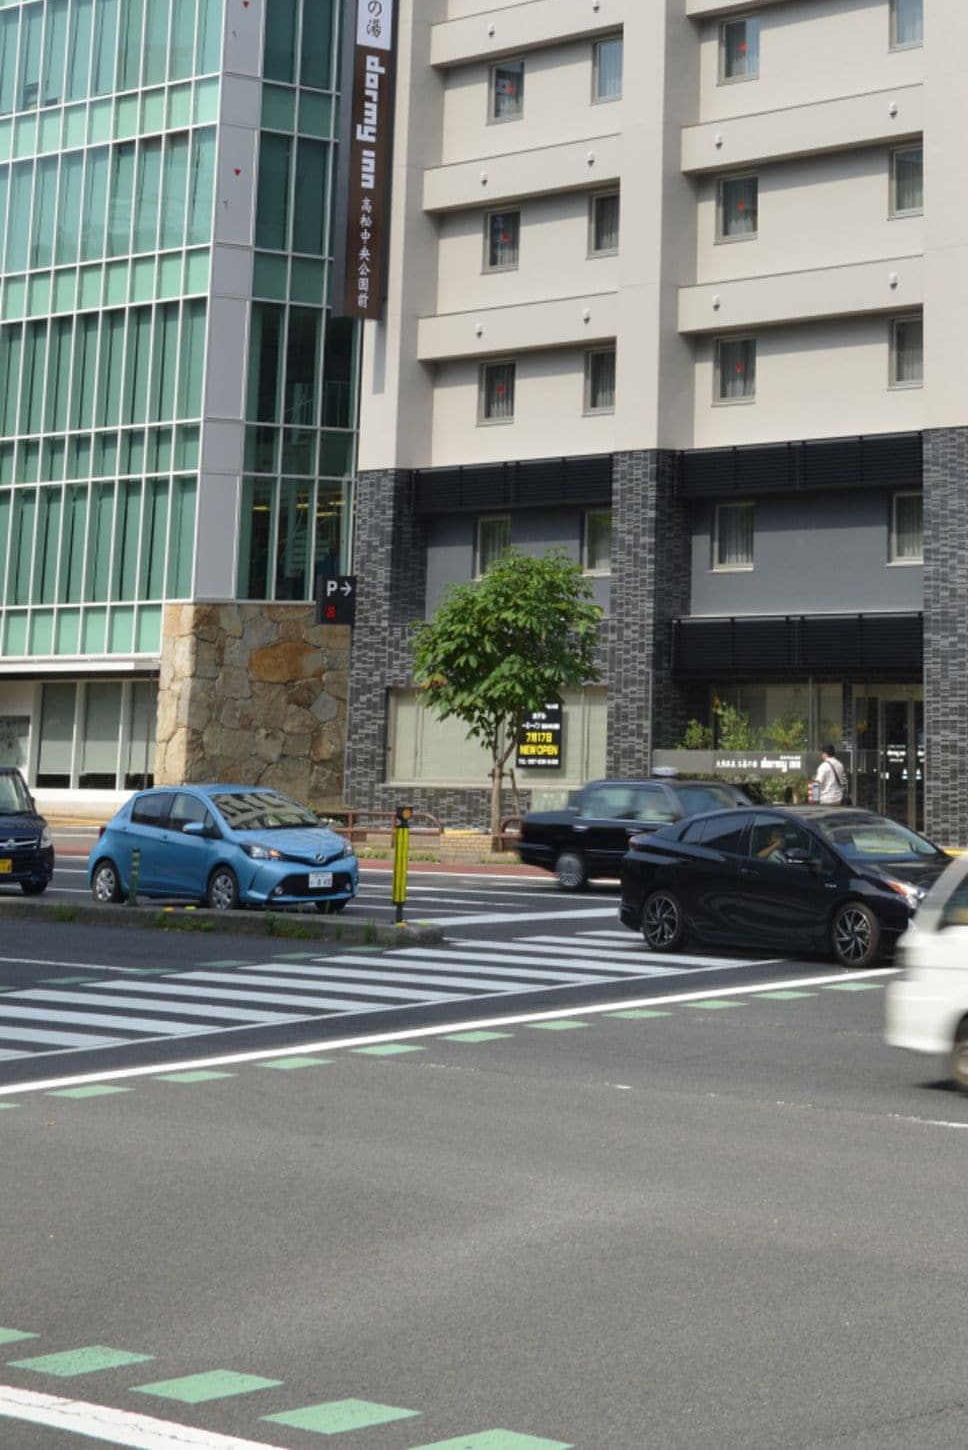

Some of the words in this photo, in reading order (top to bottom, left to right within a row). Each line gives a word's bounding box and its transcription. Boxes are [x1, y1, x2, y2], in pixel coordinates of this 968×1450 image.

[356, 55, 385, 143] dormy
[361, 150, 375, 189] inn
[358, 196, 373, 308] 高松中央公園前
[327, 580, 338, 597] P
